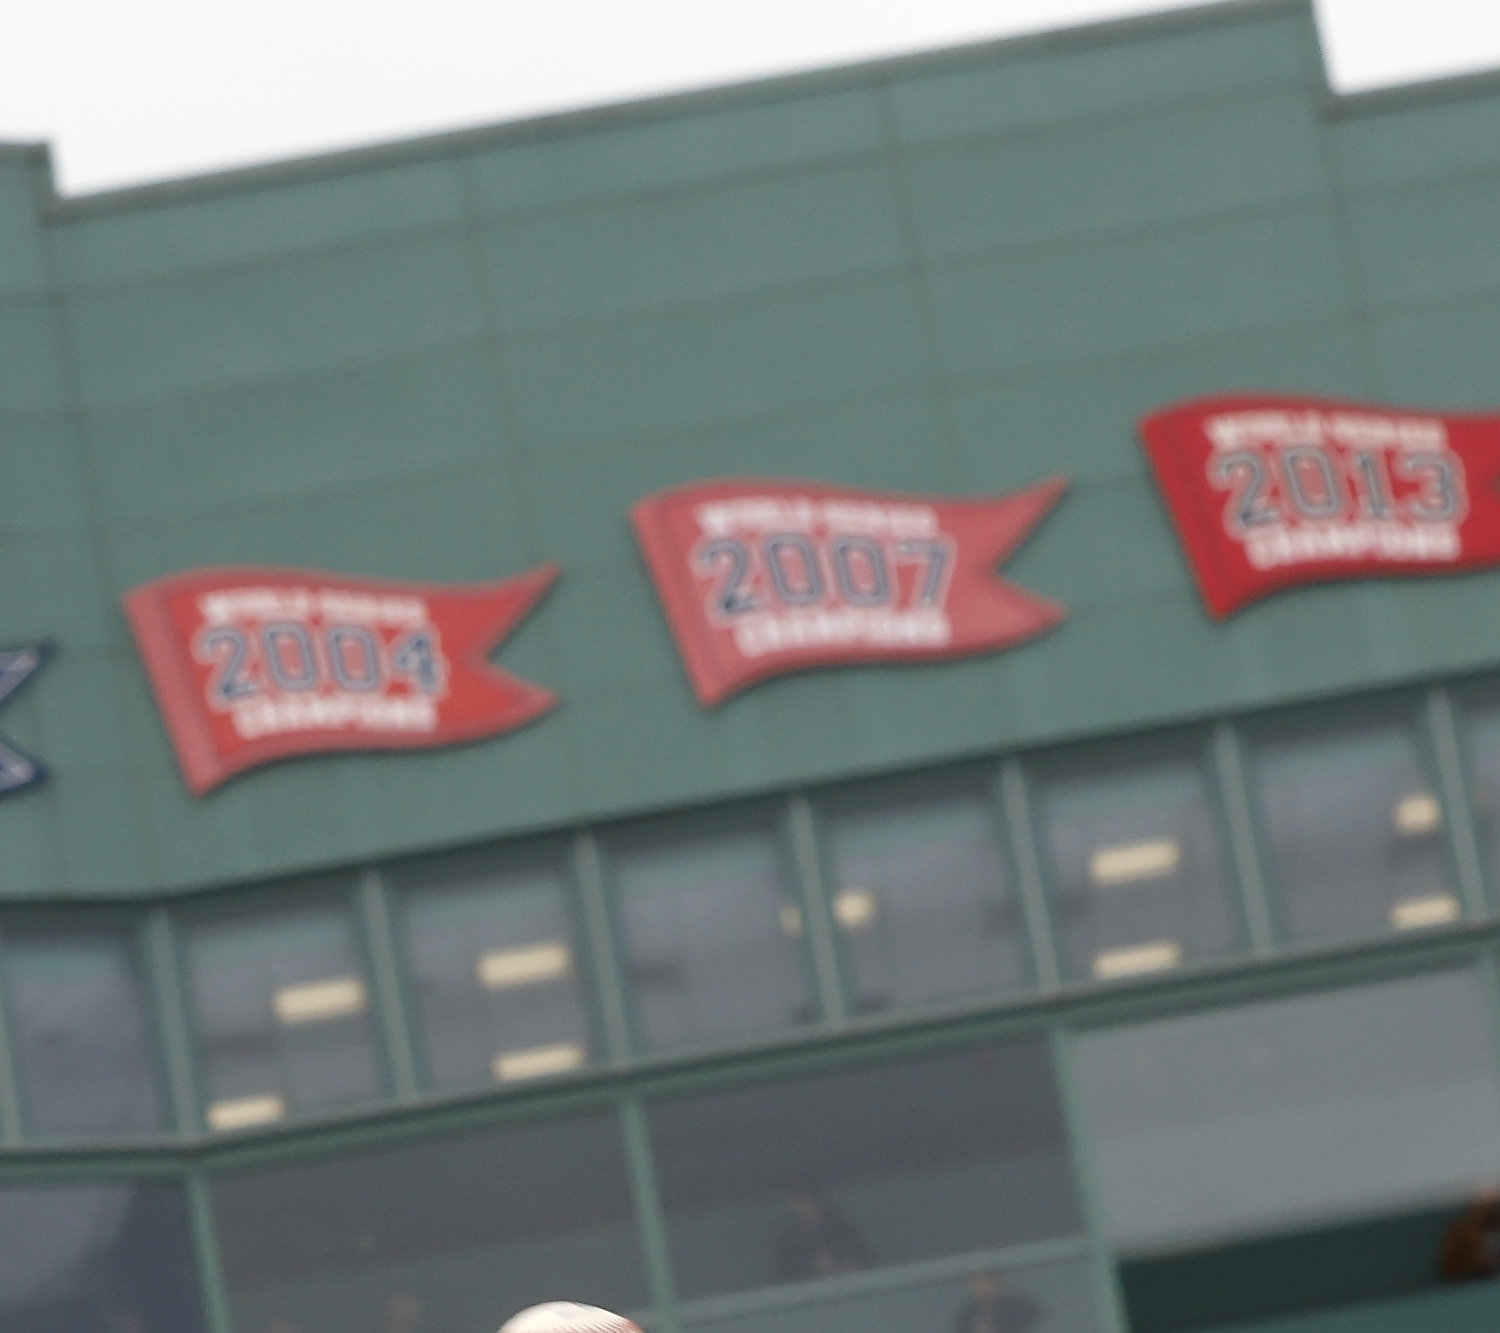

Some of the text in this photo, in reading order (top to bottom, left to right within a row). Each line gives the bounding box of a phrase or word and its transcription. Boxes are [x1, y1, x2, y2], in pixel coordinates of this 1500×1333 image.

[1206, 446, 1468, 539] 2013
[689, 532, 957, 626] 2007
[192, 621, 447, 711] 2004
